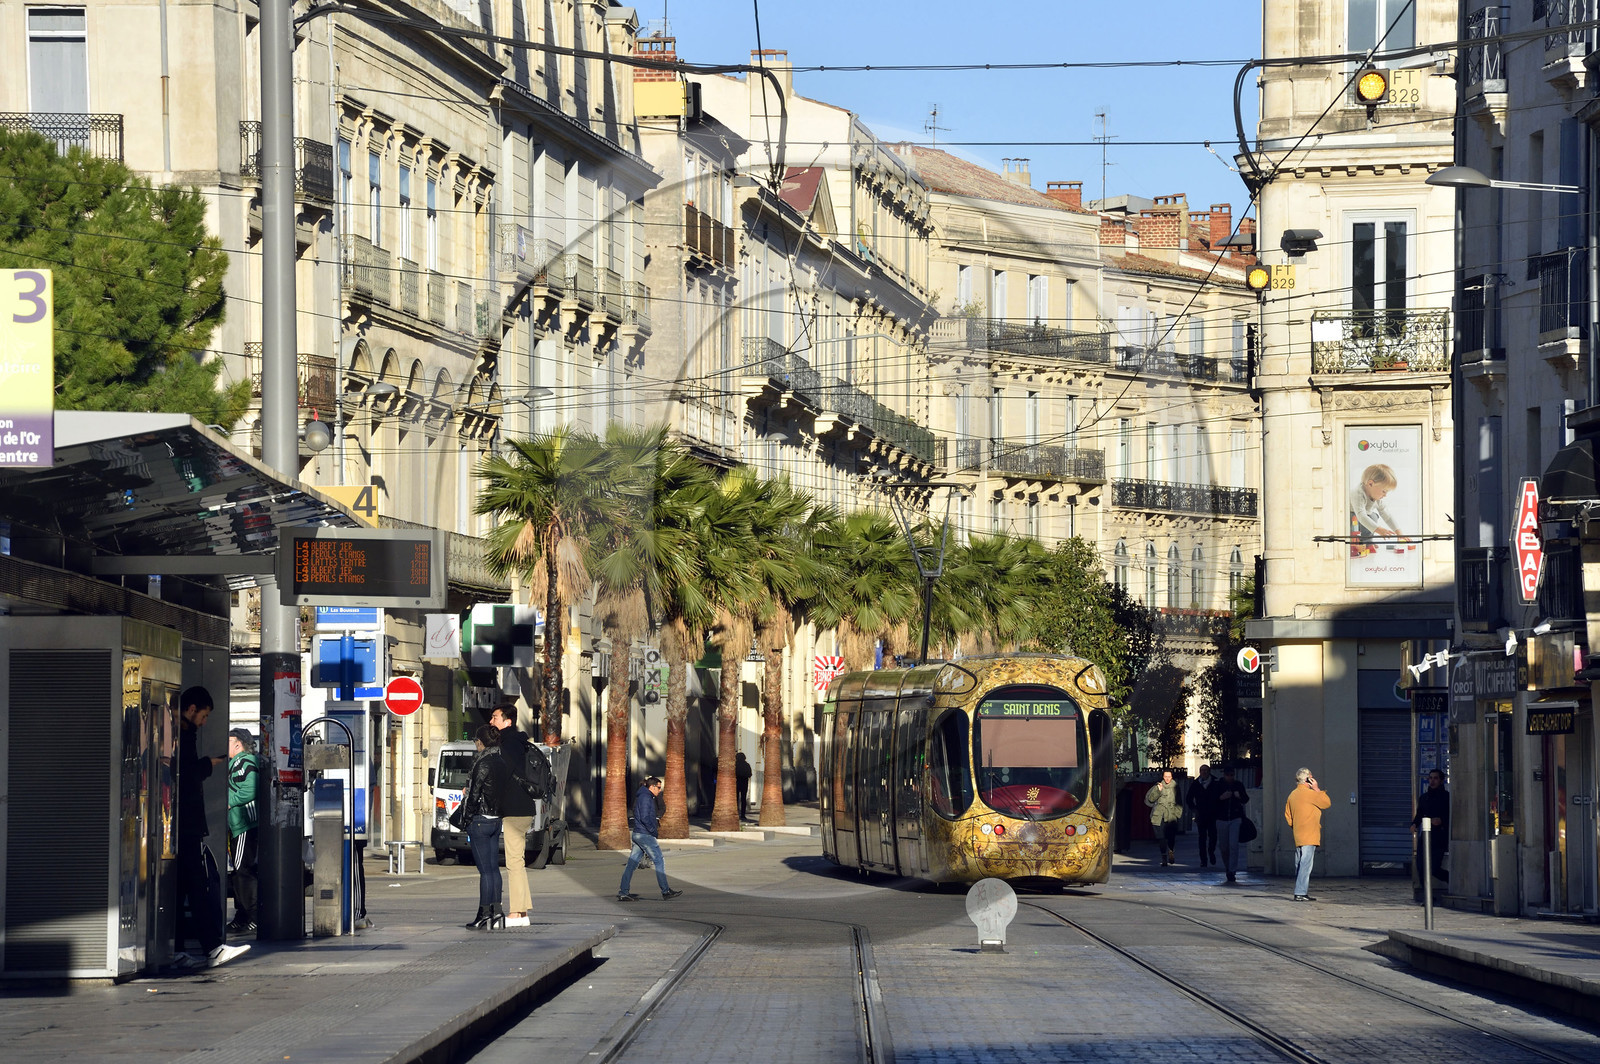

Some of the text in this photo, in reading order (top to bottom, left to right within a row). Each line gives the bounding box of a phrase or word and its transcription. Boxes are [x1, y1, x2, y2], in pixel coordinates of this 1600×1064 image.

[1394, 70, 1415, 84] FT
[1389, 88, 1420, 103] 328
[1276, 264, 1291, 275] FT
[1272, 278, 1295, 289] 329
[13, 271, 47, 323] 3
[3, 431, 41, 445] de l'Or
[353, 486, 376, 517] 4
[296, 541, 309, 550] L4
[1520, 491, 1541, 592] TABAC
[296, 550, 309, 558] L3
[296, 558, 309, 566] L3
[296, 566, 309, 574] L4
[296, 574, 309, 582] L3
[1003, 703, 1031, 715] SAINT
[1033, 703, 1060, 715] DENIS
